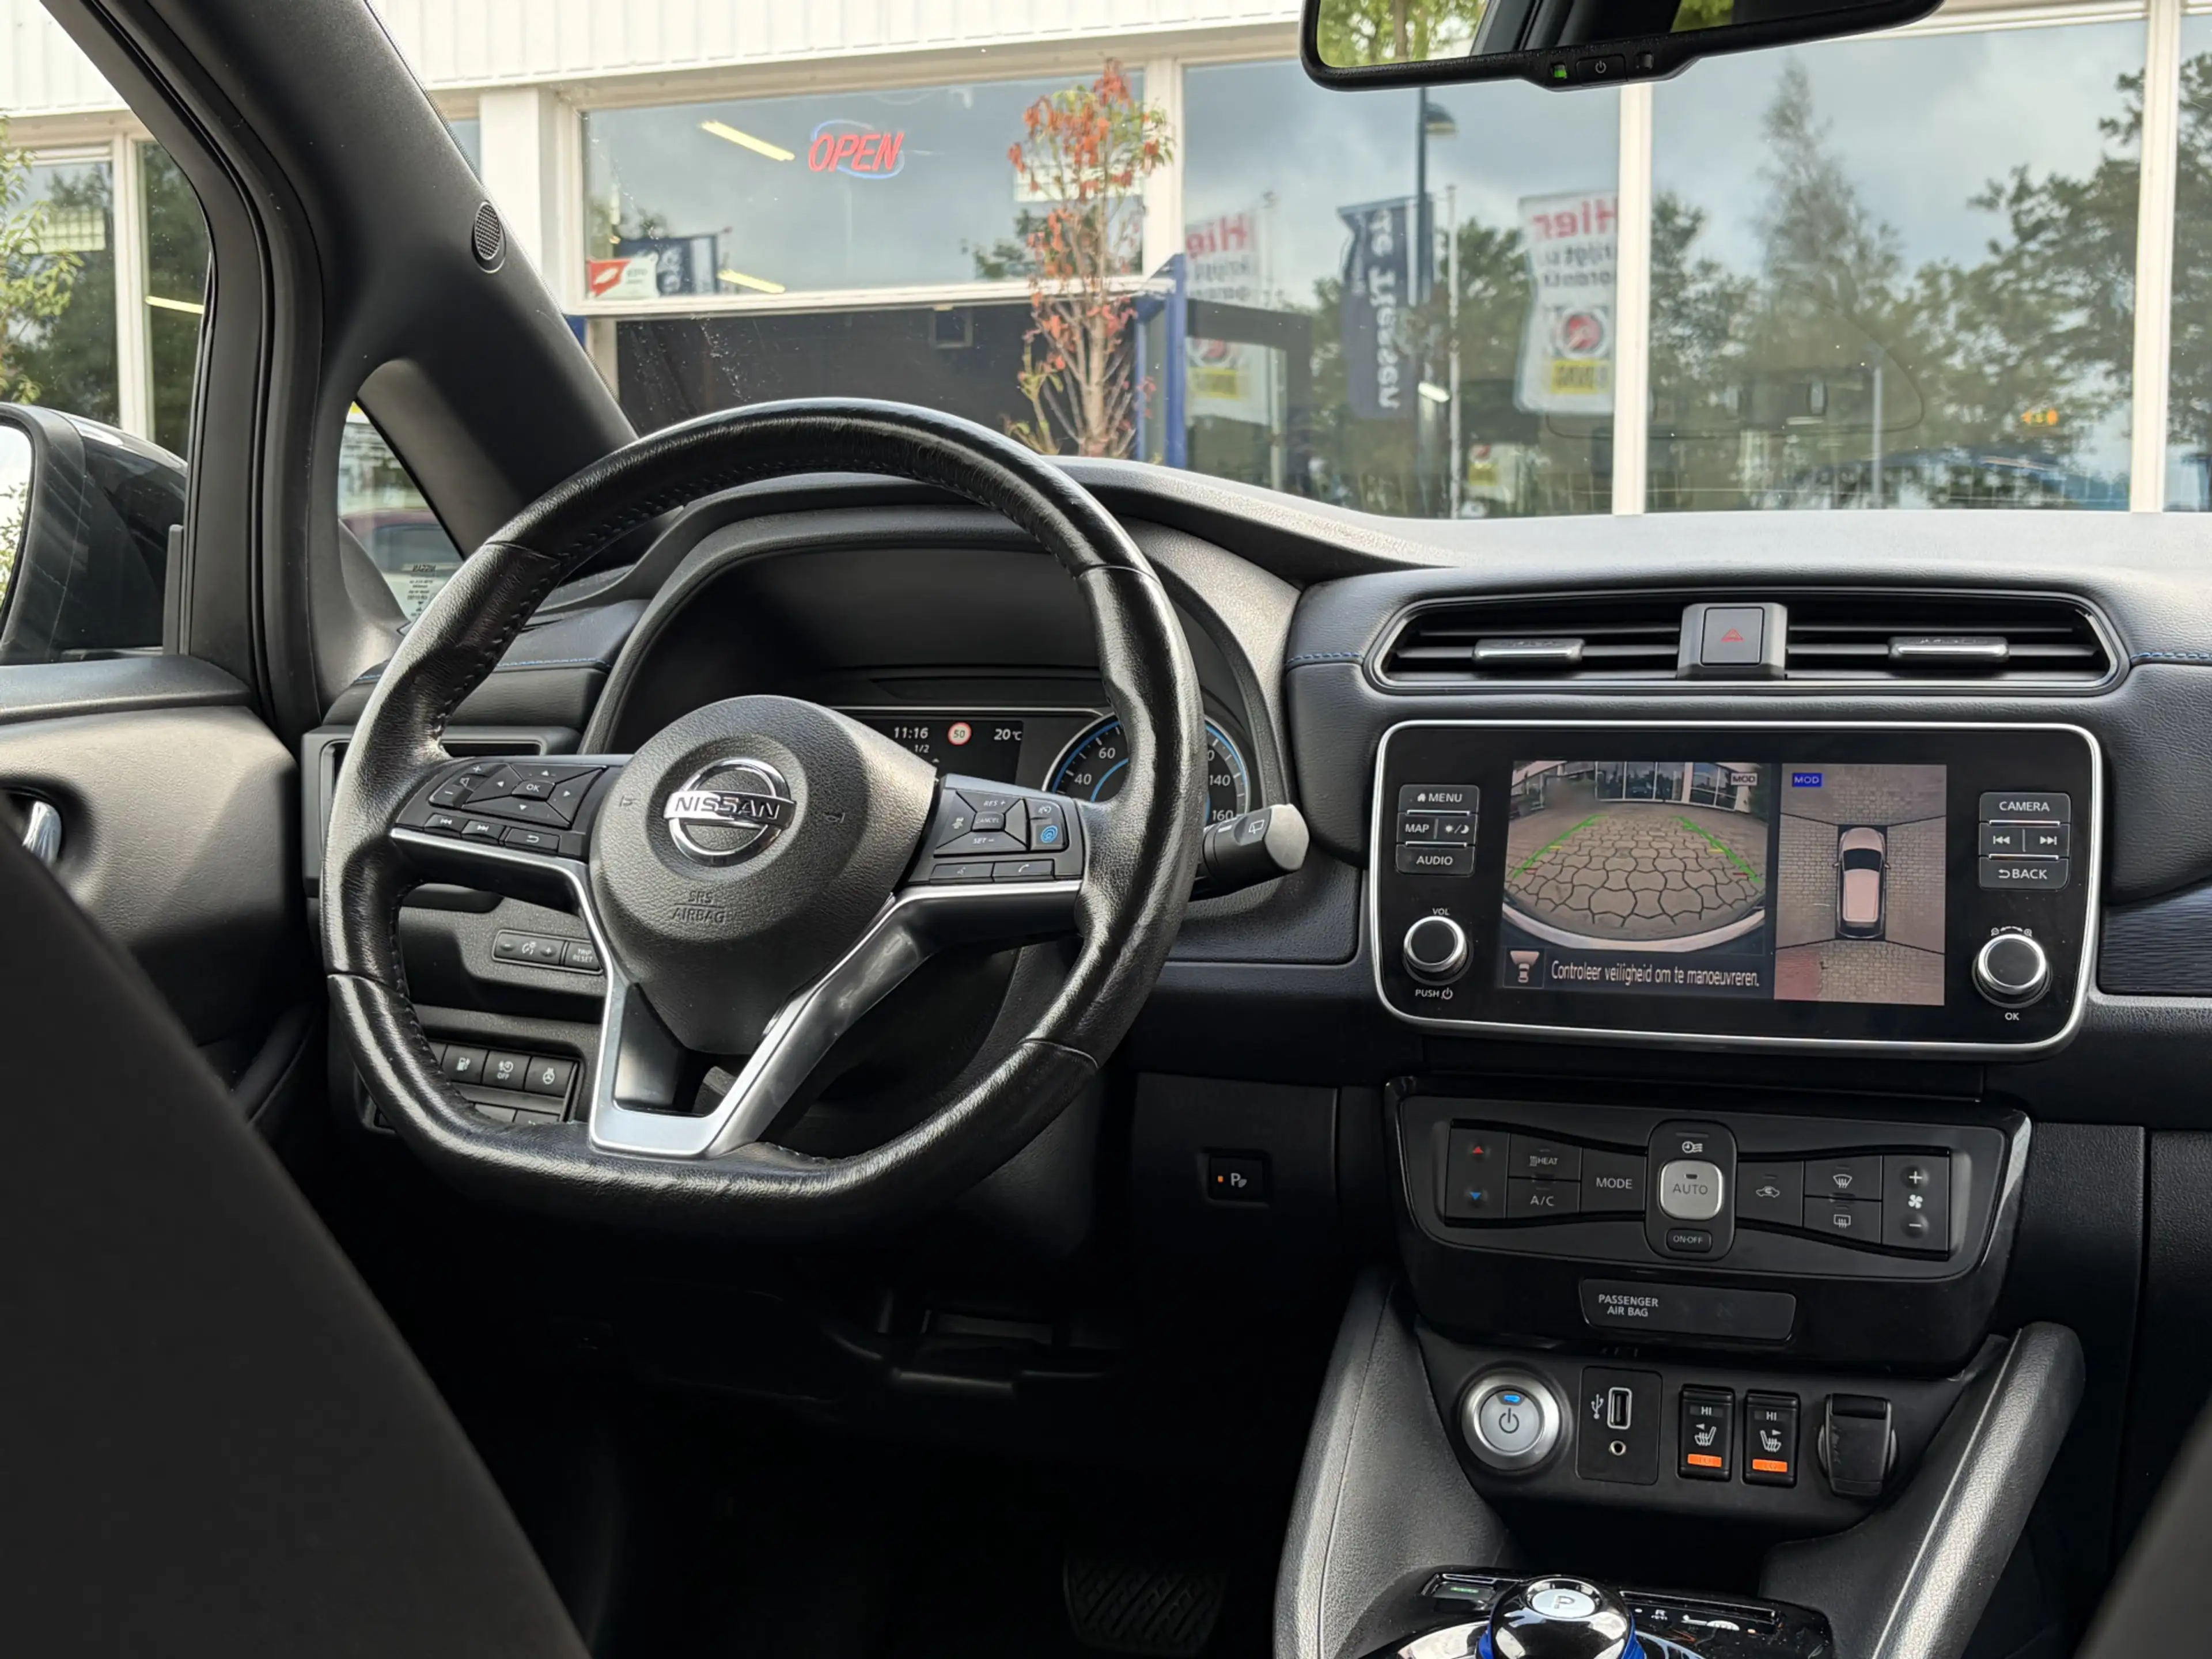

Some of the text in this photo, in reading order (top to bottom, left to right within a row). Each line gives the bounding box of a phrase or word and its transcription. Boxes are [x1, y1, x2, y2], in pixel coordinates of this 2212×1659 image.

[808, 131, 904, 172] OPEN
[894, 727, 929, 739] 11:16
[953, 729, 965, 738] 50
[914, 744, 930, 753] 1/2
[1099, 747, 1116, 759] 60
[1074, 774, 1092, 785] 40
[1210, 775, 1230, 786] 140
[1732, 775, 1756, 783] MOD
[1793, 775, 1820, 784] MOD
[526, 783, 540, 793] OK
[1428, 793, 1463, 803] MENU
[675, 797, 780, 820] NISSAN
[1999, 801, 2050, 812] CAMERA
[1212, 810, 1234, 821] 160
[1404, 823, 1430, 833] MAP
[1416, 855, 1453, 866] AUDIO
[2012, 868, 2048, 880] BACK
[688, 891, 713, 903] SRS
[672, 908, 725, 923] AIRBAG
[1432, 907, 1450, 916] VOL
[1551, 961, 1760, 987] Controleer veiligheid om te manoeuvreren.
[1415, 988, 1440, 998] PUSH
[2005, 1012, 2020, 1021] OK
[497, 1071, 510, 1080] OFF
[1537, 1157, 1558, 1165] HEAT
[1596, 1177, 1633, 1190] MODE
[1673, 1183, 1709, 1195] AUTO
[1530, 1195, 1555, 1206] A/C
[1599, 1294, 1658, 1307] PASSENGER
[1607, 1305, 1649, 1317] AIR BAG
[1700, 1406, 1712, 1415] HI
[1766, 1411, 1777, 1421] HI
[1553, 1596, 1575, 1609] P
